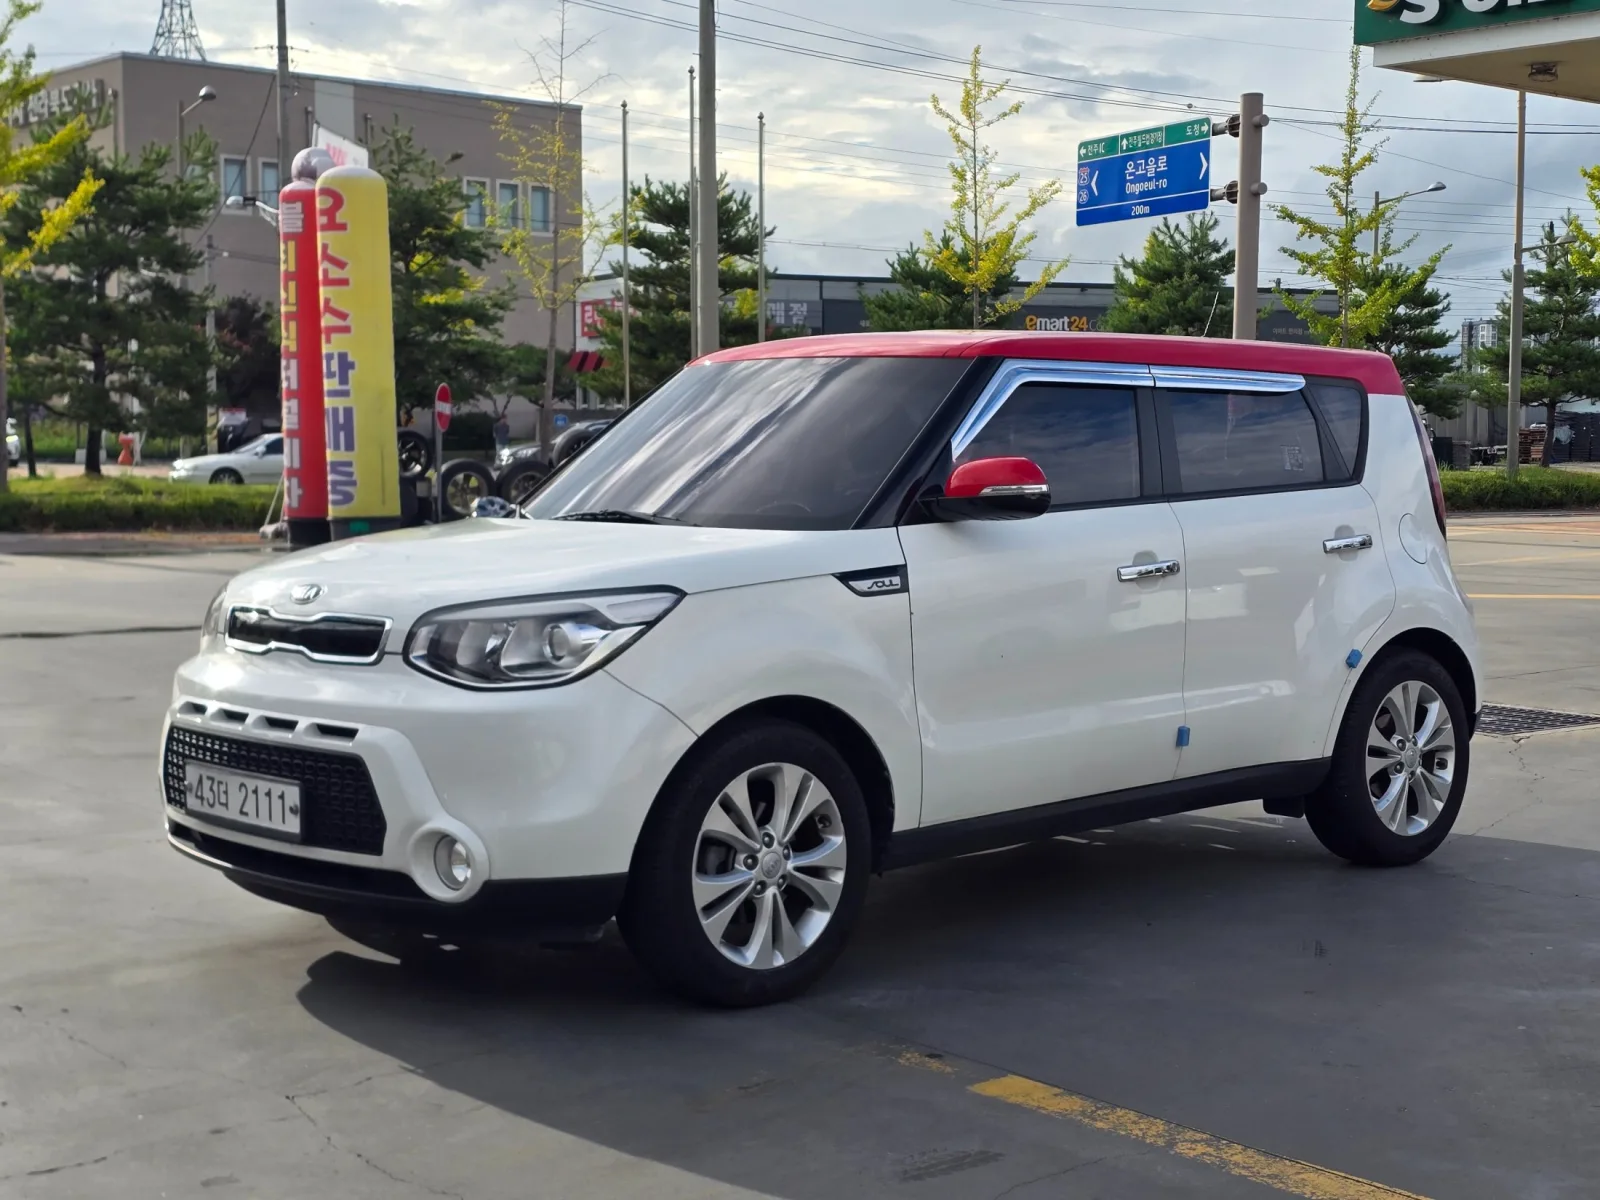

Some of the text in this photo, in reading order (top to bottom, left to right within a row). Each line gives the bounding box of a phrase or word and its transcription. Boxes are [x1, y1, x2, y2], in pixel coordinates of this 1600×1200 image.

[1185, 123, 1200, 136] 도청
[1124, 155, 1168, 180] 온고을로
[1125, 178, 1168, 195] Ongoeul-ro
[1131, 204, 1150, 216] 200m
[1025, 315, 1088, 331] emart24
[194, 773, 286, 825] 43더 2111
